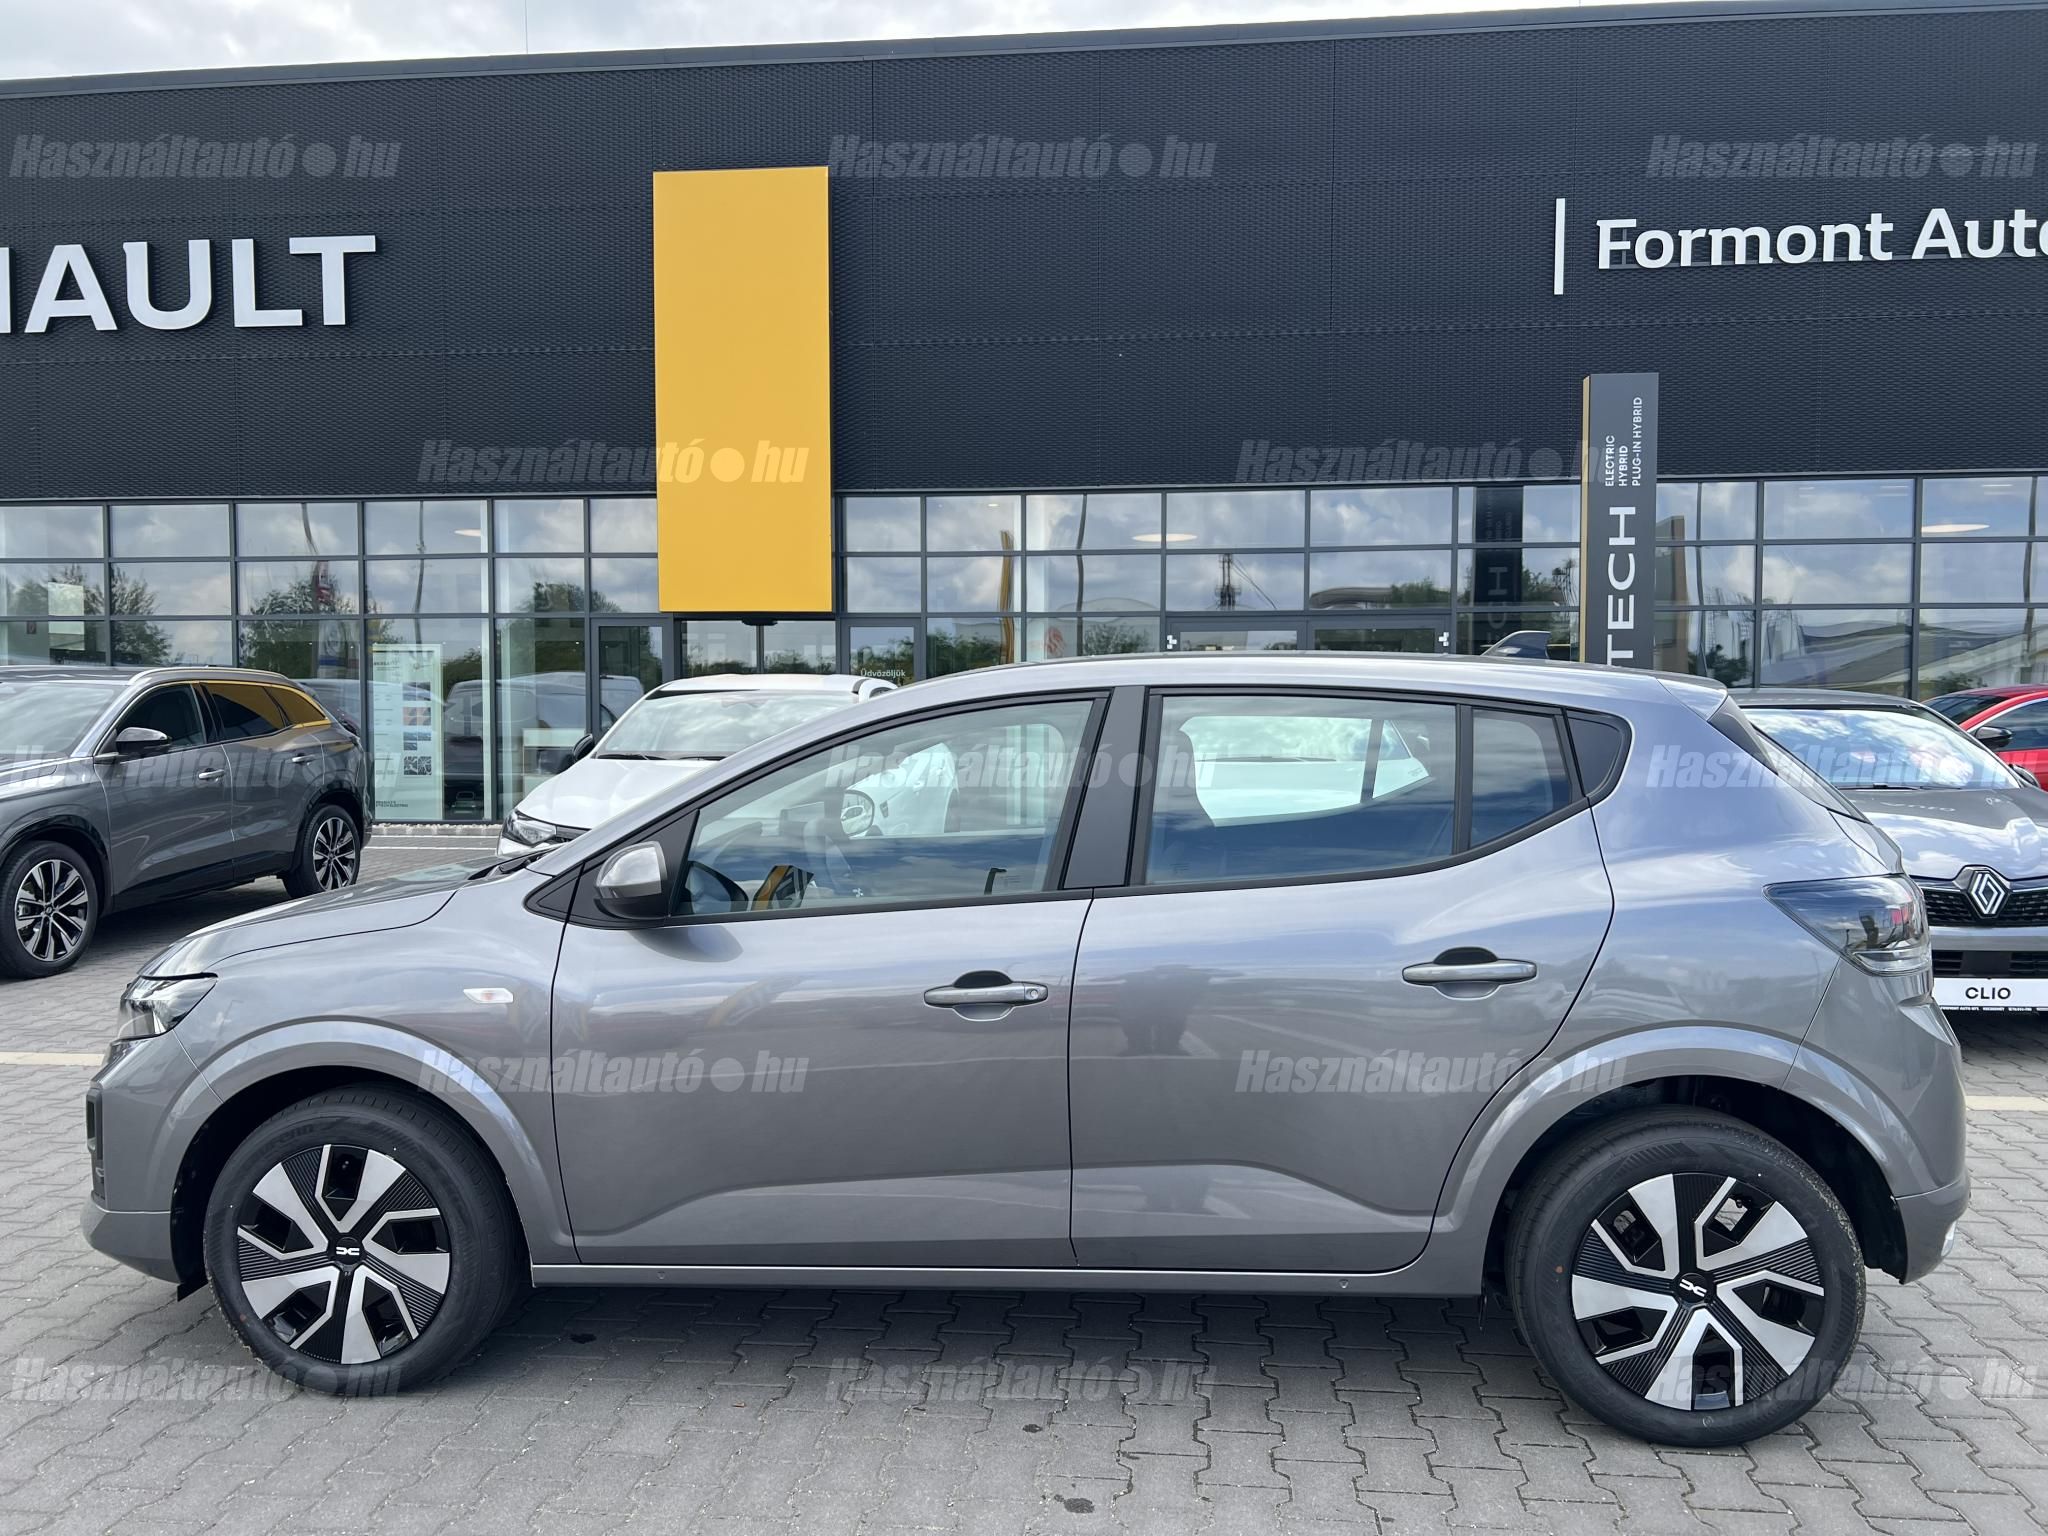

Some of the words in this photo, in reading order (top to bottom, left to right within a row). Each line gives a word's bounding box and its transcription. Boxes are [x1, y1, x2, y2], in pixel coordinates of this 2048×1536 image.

[1596, 213, 1894, 269] Formont
[1911, 208, 2048, 259] Aut
[0, 235, 376, 333] AULT
[1633, 397, 1643, 438] HYBRID
[1605, 435, 1615, 486] ELECTRIC
[1619, 445, 1628, 486] HYBRID
[1632, 441, 1642, 486] PLUG-IN
[1607, 507, 1636, 666] TECH
[1965, 987, 2011, 999] CLIO
